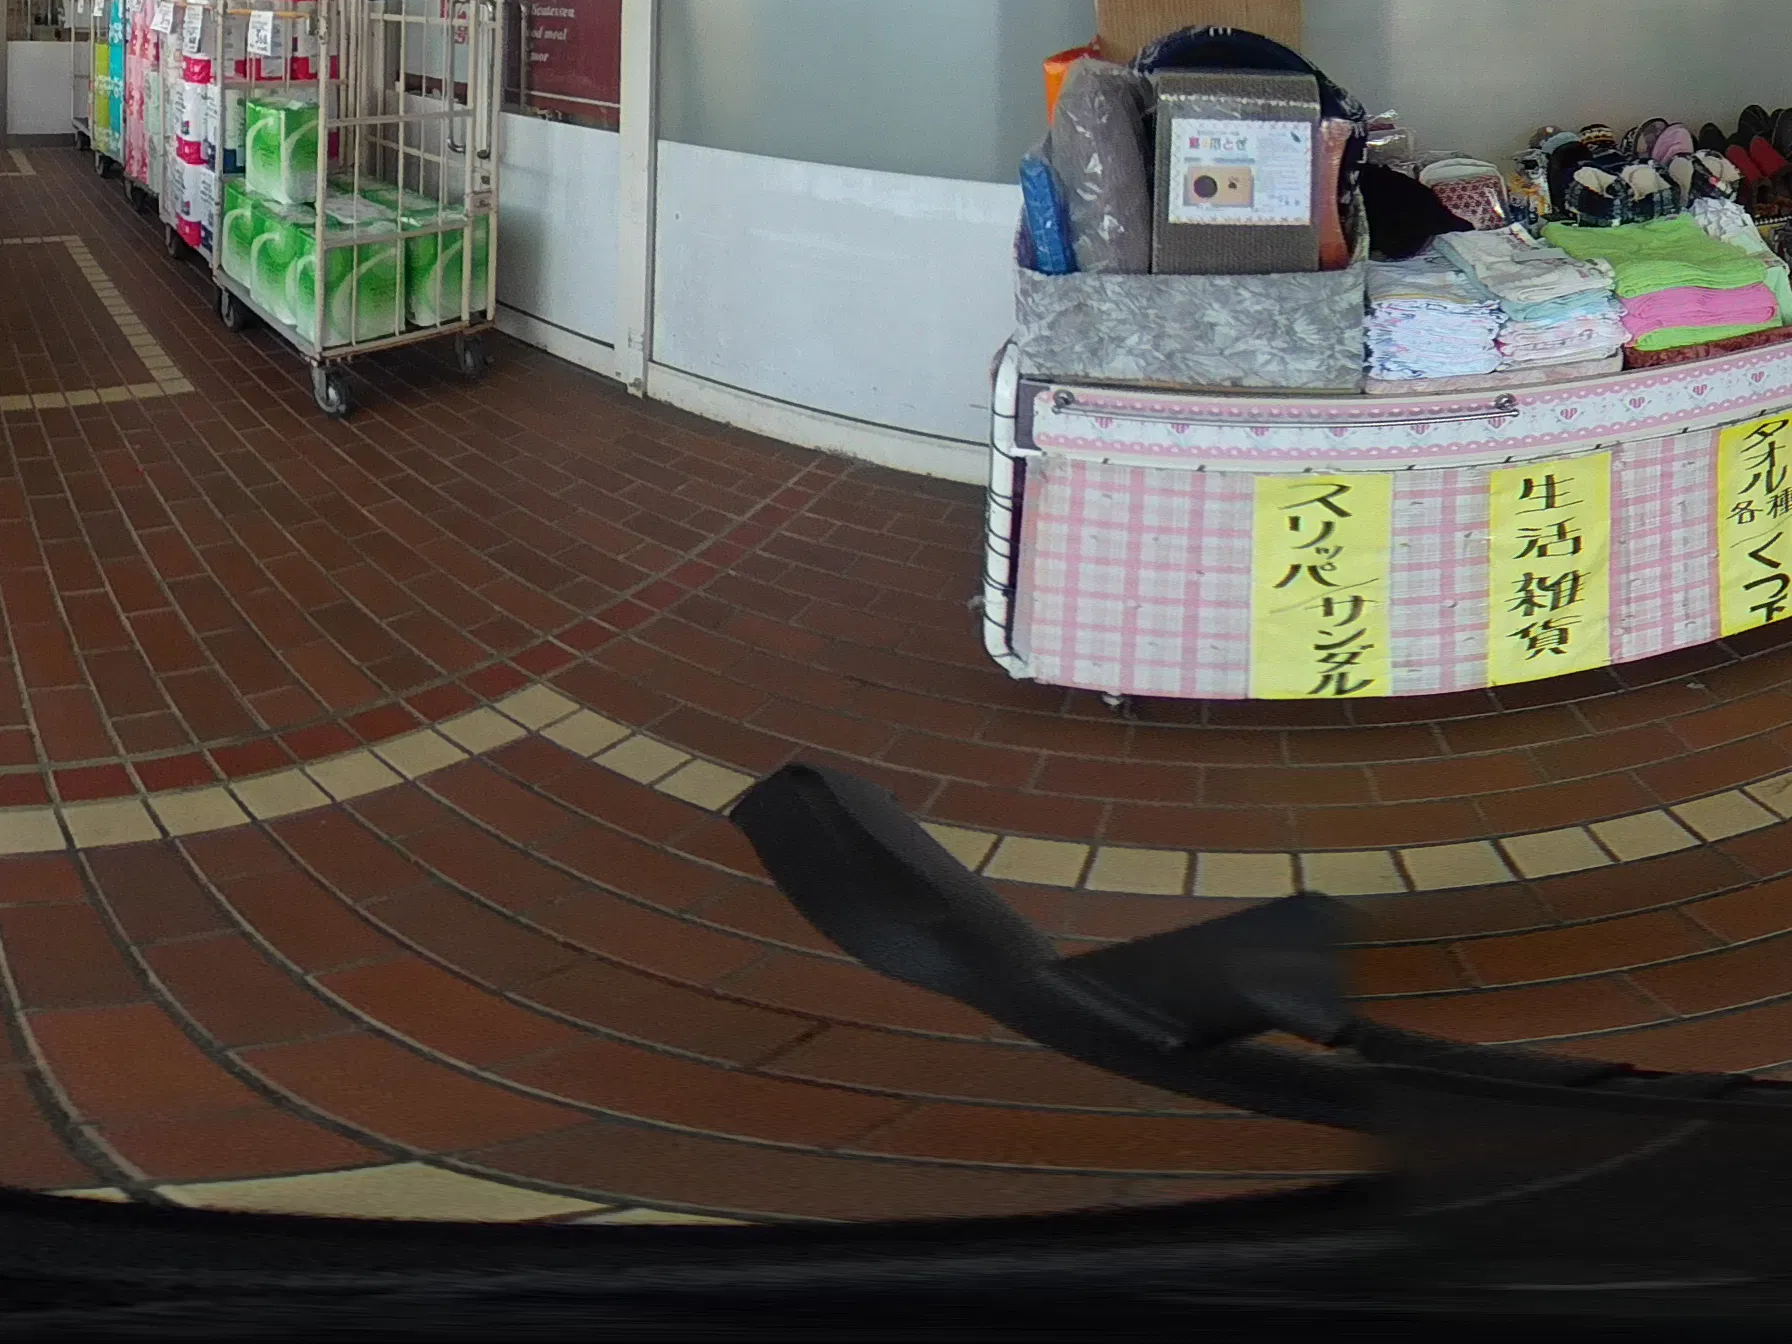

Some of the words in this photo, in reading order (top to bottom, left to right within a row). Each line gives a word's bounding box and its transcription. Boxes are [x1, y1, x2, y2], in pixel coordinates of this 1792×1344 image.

[1738, 418, 1790, 496] タオル
[1510, 474, 1587, 660] 生活雑貨
[1742, 531, 1792, 623] くつ下
